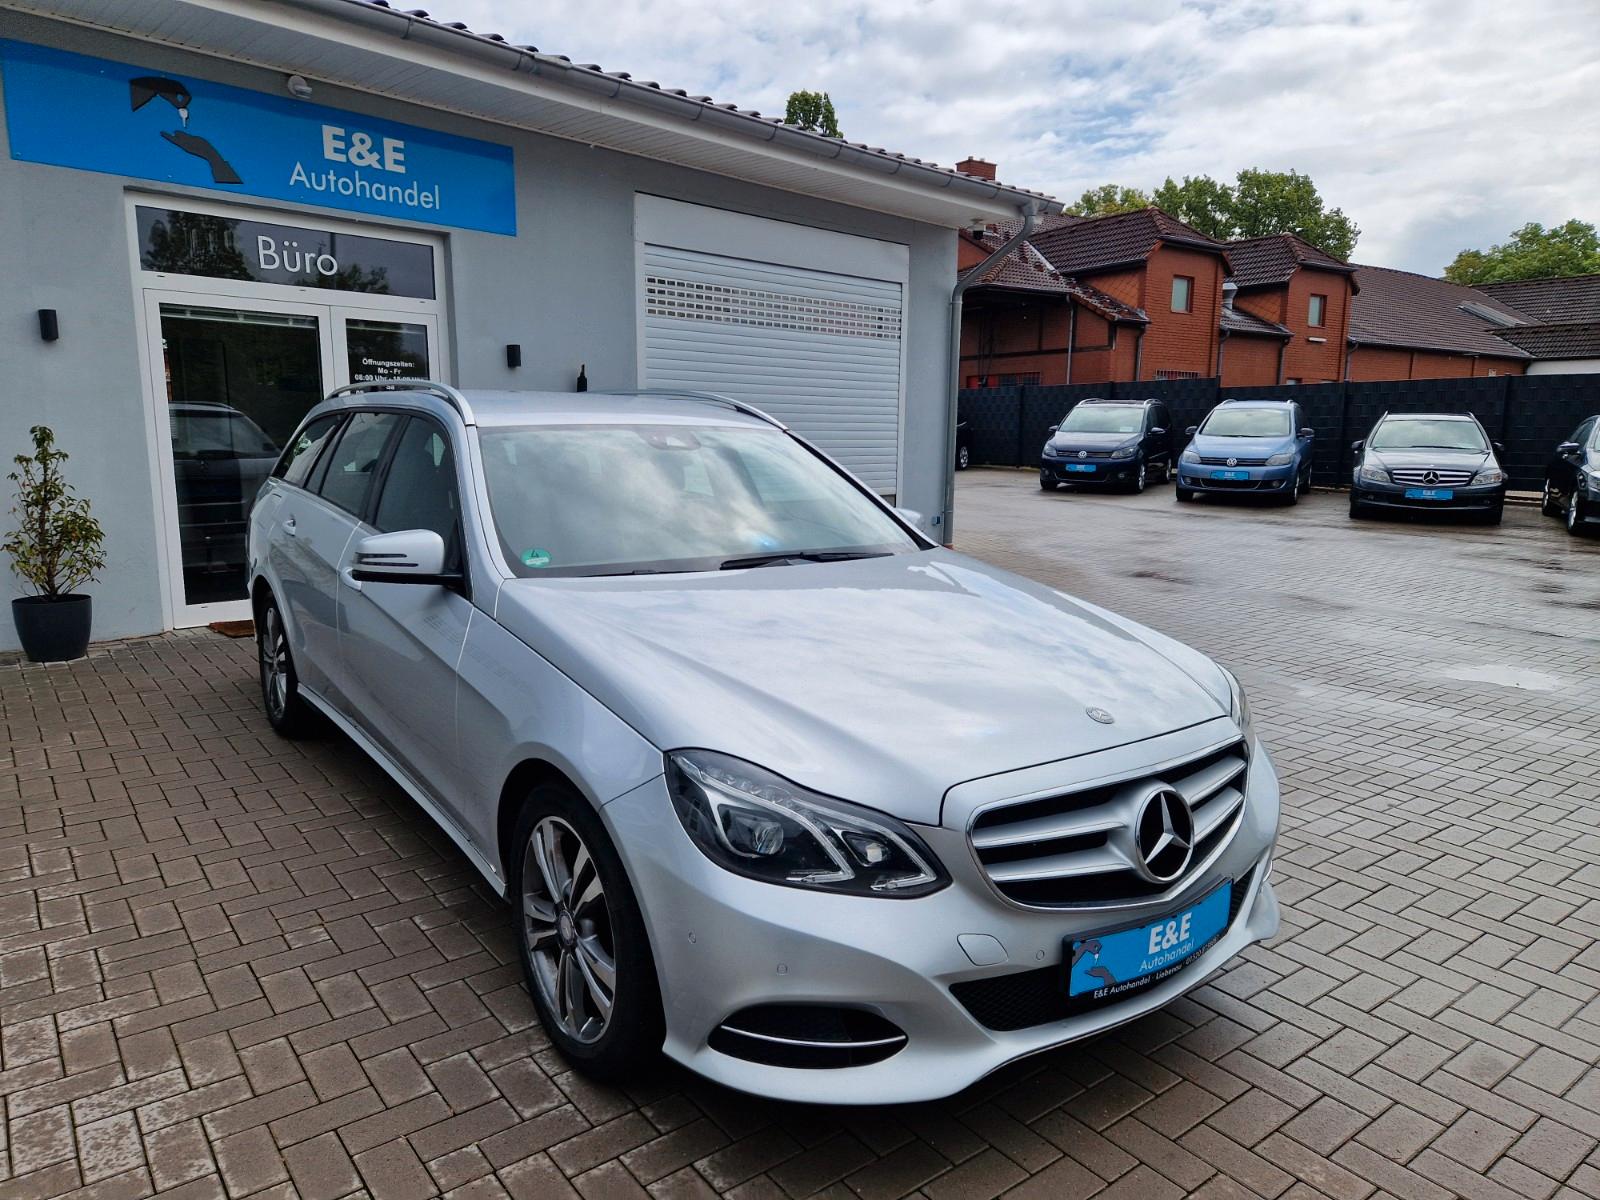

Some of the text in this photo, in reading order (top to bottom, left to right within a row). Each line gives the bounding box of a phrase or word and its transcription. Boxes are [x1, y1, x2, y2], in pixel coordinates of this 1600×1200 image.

[322, 125, 406, 174] E&E
[289, 161, 440, 210] Autohandel
[257, 235, 338, 276] Büro
[362, 357, 415, 368] Öffnungszeiten:
[1148, 911, 1193, 955] E&E
[1139, 938, 1195, 973] Autohandel
[1093, 987, 1109, 999] E&E
[1109, 975, 1151, 994] Autohandel
